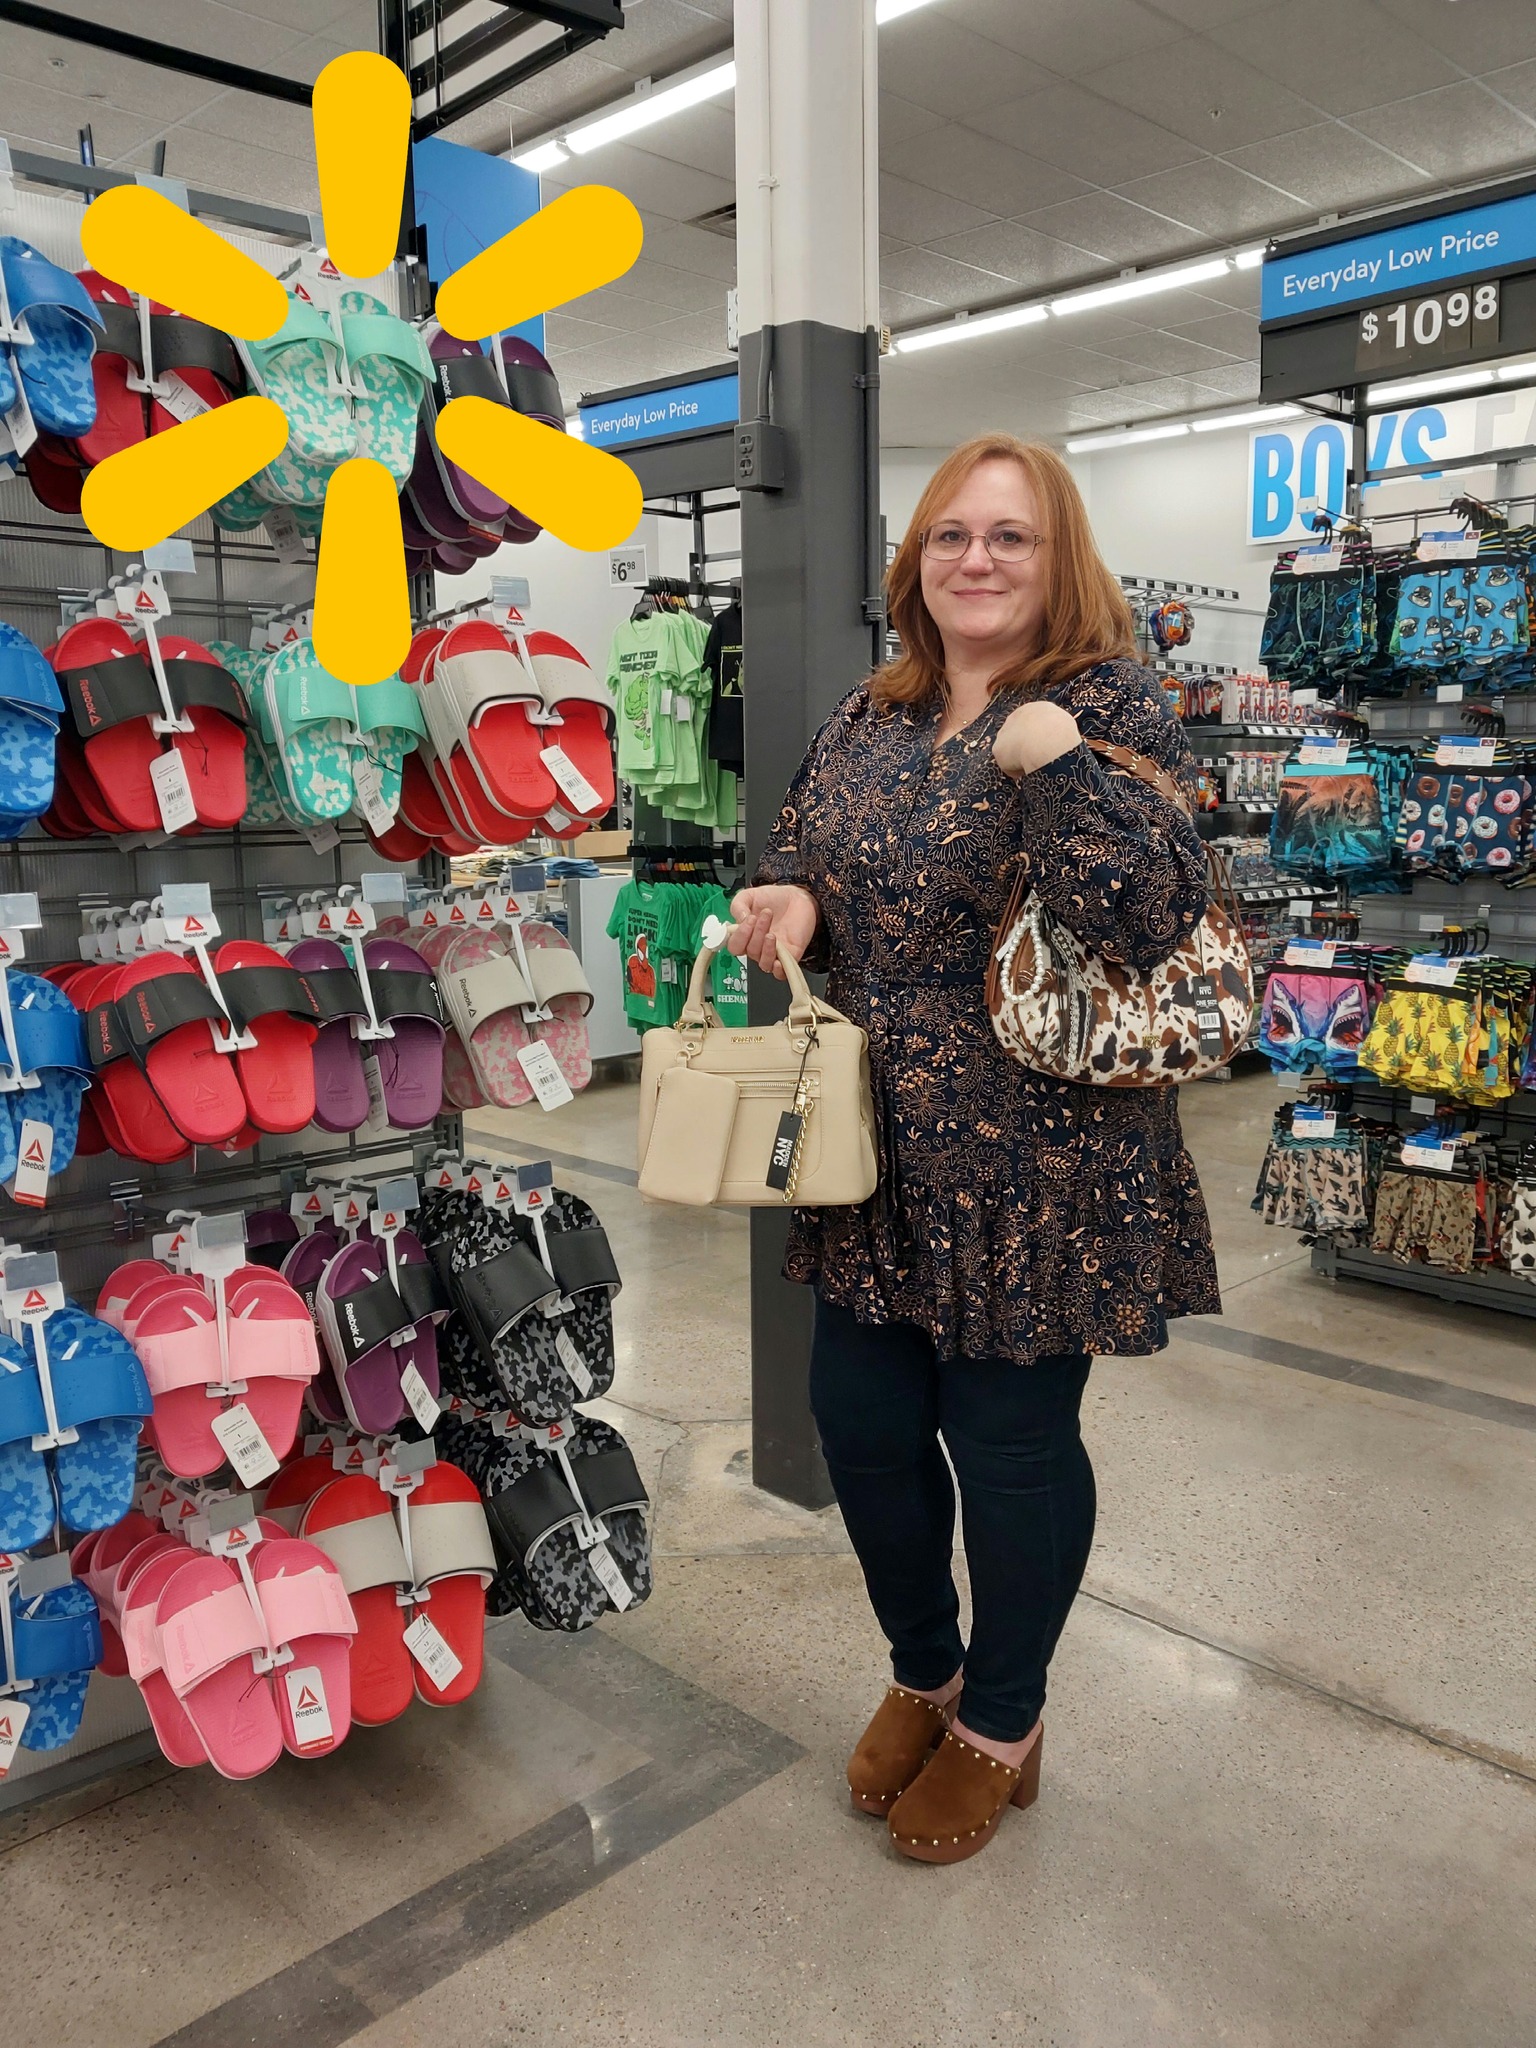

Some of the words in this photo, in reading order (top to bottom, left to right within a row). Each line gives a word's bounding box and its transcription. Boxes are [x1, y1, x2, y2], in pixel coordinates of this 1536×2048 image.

[317, 272, 342, 281] Reebok
[1283, 259, 1382, 297] Everyday
[1388, 248, 1433, 271] Low
[1441, 230, 1500, 259] Price
[440, 365, 453, 397] Reebok
[591, 412, 641, 435] Everyday
[643, 408, 666, 424] Low
[669, 400, 699, 419] Price
[135, 607, 159, 615] Reebok
[301, 615, 307, 625] 2
[79, 679, 96, 714] Reebok
[299, 676, 308, 706] Reebok
[505, 911, 522, 919] Reebok
[183, 931, 208, 939] Reebok
[136, 991, 151, 1022] Reebok
[459, 978, 472, 1008] Reebok
[100, 1011, 110, 1043] Reebok
[20, 1158, 46, 1172] Reebok
[773, 1137, 788, 1166] NYC
[21, 1305, 50, 1316] Reebok
[344, 1303, 360, 1336] Reebok
[131, 1374, 144, 1409] Reebok
[393, 1481, 414, 1490] Reebok
[226, 1540, 250, 1551] Reebok
[295, 1705, 324, 1719] Reebok
